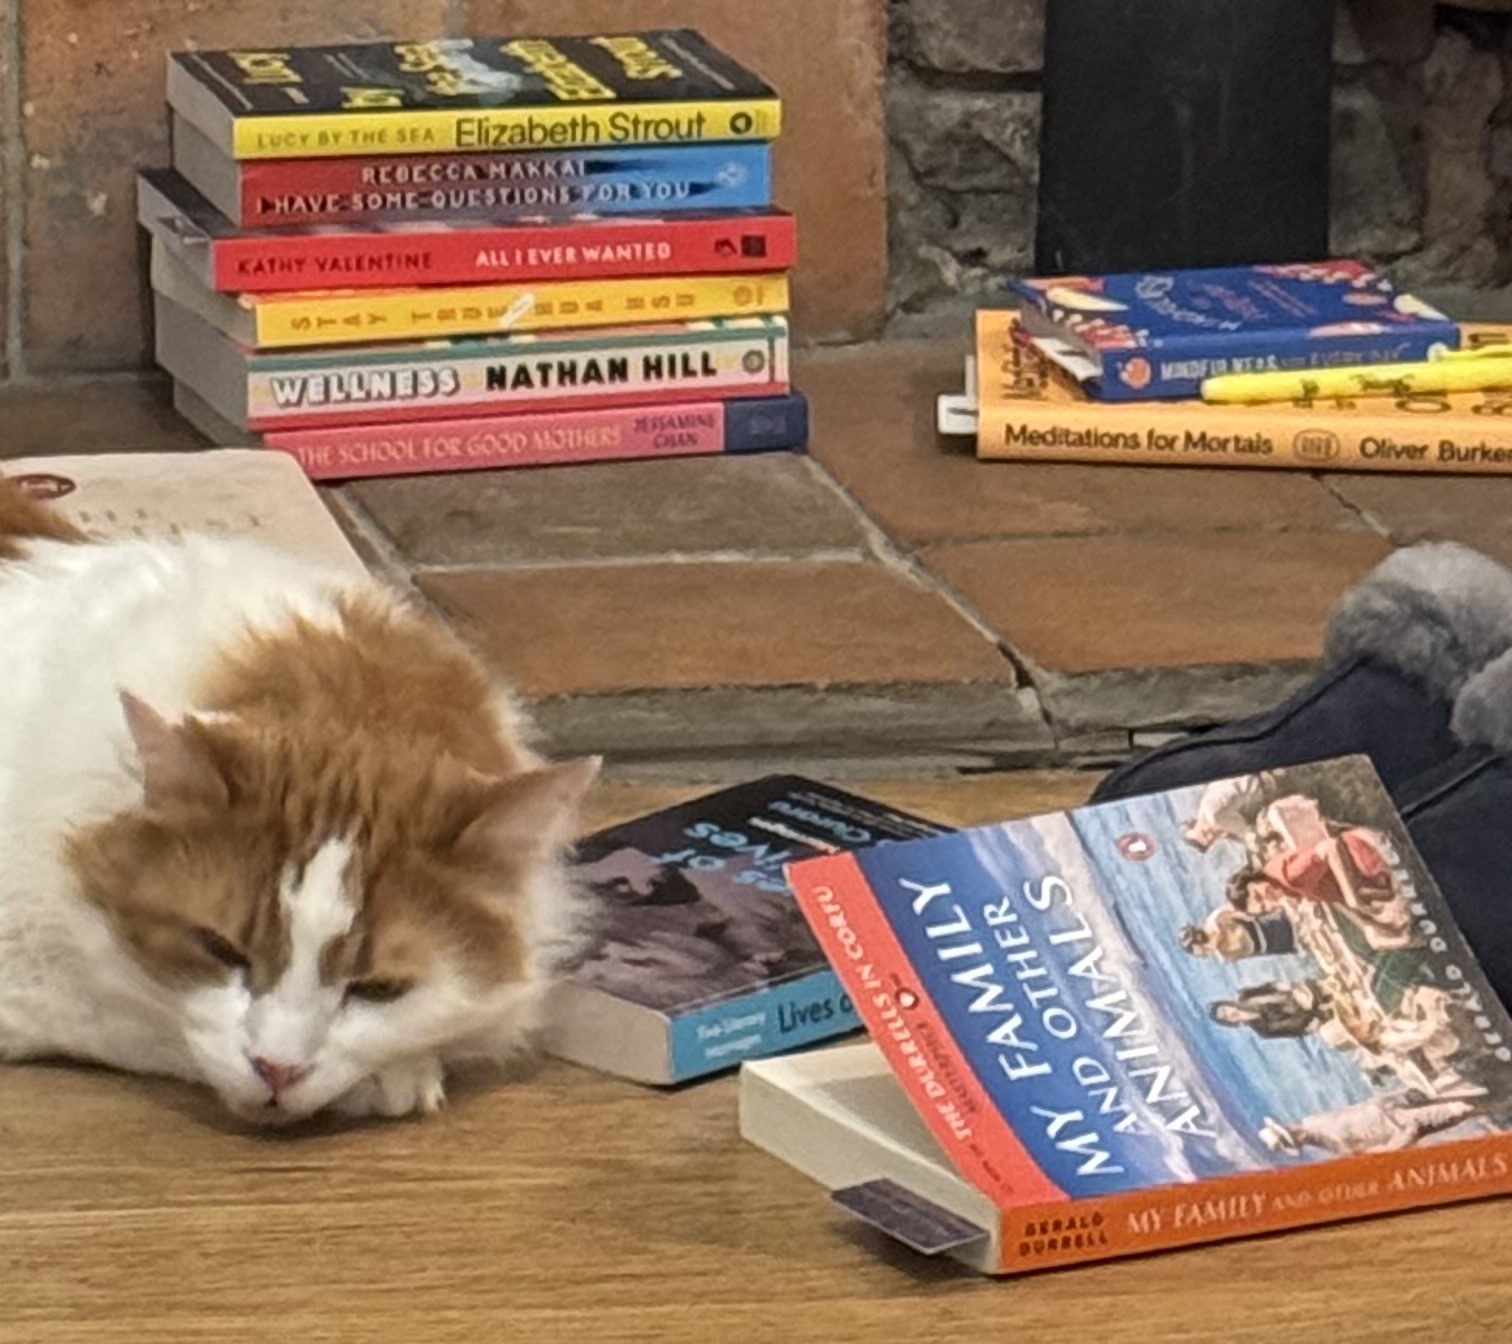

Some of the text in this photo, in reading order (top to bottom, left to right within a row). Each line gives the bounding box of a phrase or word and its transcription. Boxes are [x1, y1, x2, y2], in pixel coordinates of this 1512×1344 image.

[257, 110, 707, 149] LUCY BY THE SEA Elizabeth Strout
[360, 159, 586, 185] REBECCA MAKKAI
[273, 192, 339, 213] HAVE
[351, 189, 419, 210] SOME
[431, 183, 572, 210] QUESTIONS
[582, 181, 631, 202] FOR
[639, 179, 691, 200] YOU
[237, 256, 307, 275] KATHY
[315, 252, 432, 274] VALENTINE
[475, 249, 509, 268] ALL
[527, 245, 577, 265] EVER
[582, 241, 672, 263] WANTED
[291, 312, 387, 331] STAY
[270, 350, 718, 408] WELLNESS NATHAN HILL
[297, 423, 624, 467] THE SCHOOL FOR GOOD MOTHERS
[1004, 423, 1141, 450] Meditations
[1146, 427, 1179, 452] for
[1184, 429, 1274, 455] Mortals
[1359, 435, 1430, 461] Oliver
[899, 876, 1054, 1082] FAMILY
[983, 896, 1078, 1041] OTHER
[777, 998, 835, 1034] Lives
[810, 885, 974, 1141] THE DURRELLS IN CORFU
[1023, 874, 1218, 1140] ANIMALS
[1072, 1056, 1151, 1137] AND
[1030, 1105, 1126, 1177] MY
[1126, 1151, 1509, 1234] MY FAMILY AND OTHER ANIMALS
[1018, 1230, 1109, 1257] DURRELL
[1024, 1212, 1105, 1238] GERALD
